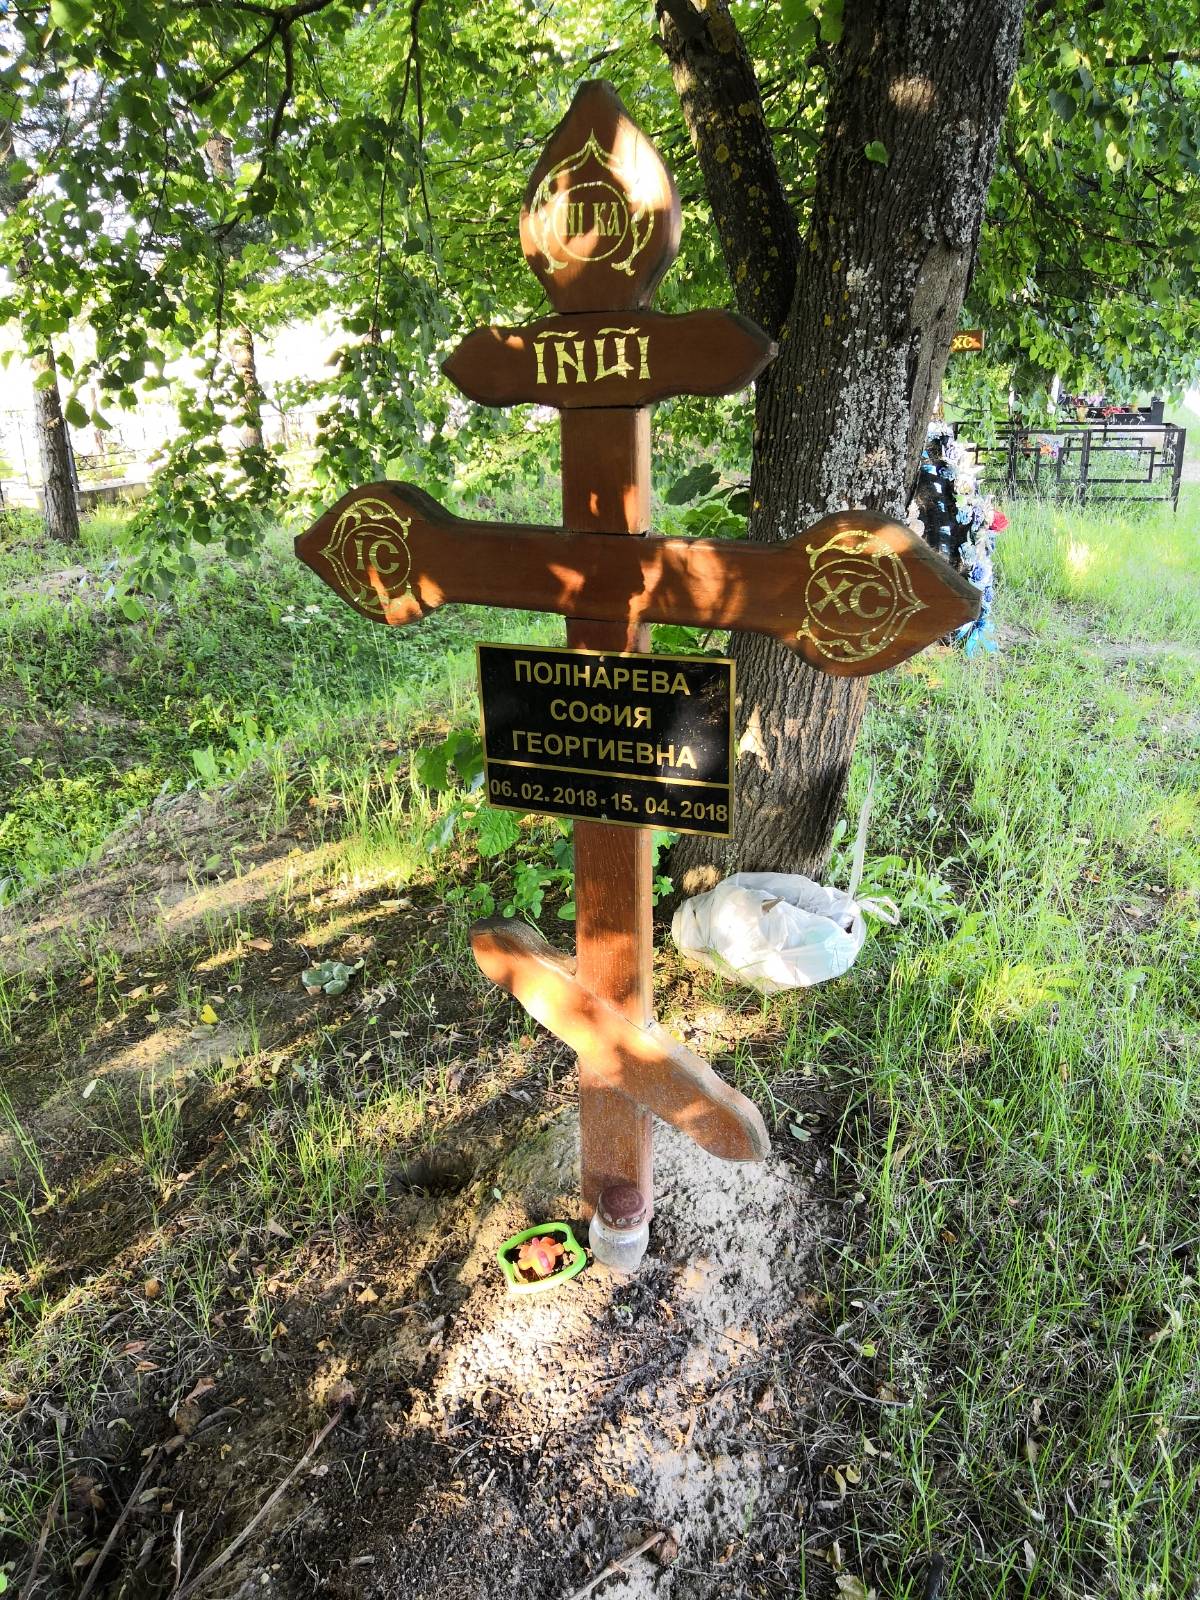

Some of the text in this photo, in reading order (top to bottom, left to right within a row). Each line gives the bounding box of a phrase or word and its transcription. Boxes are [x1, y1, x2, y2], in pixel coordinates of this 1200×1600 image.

[514, 660, 691, 696] ПОЛНАРЕВА
[550, 699, 653, 729] СОФИЯ
[512, 730, 698, 770] ГЕОРГИЕВНА
